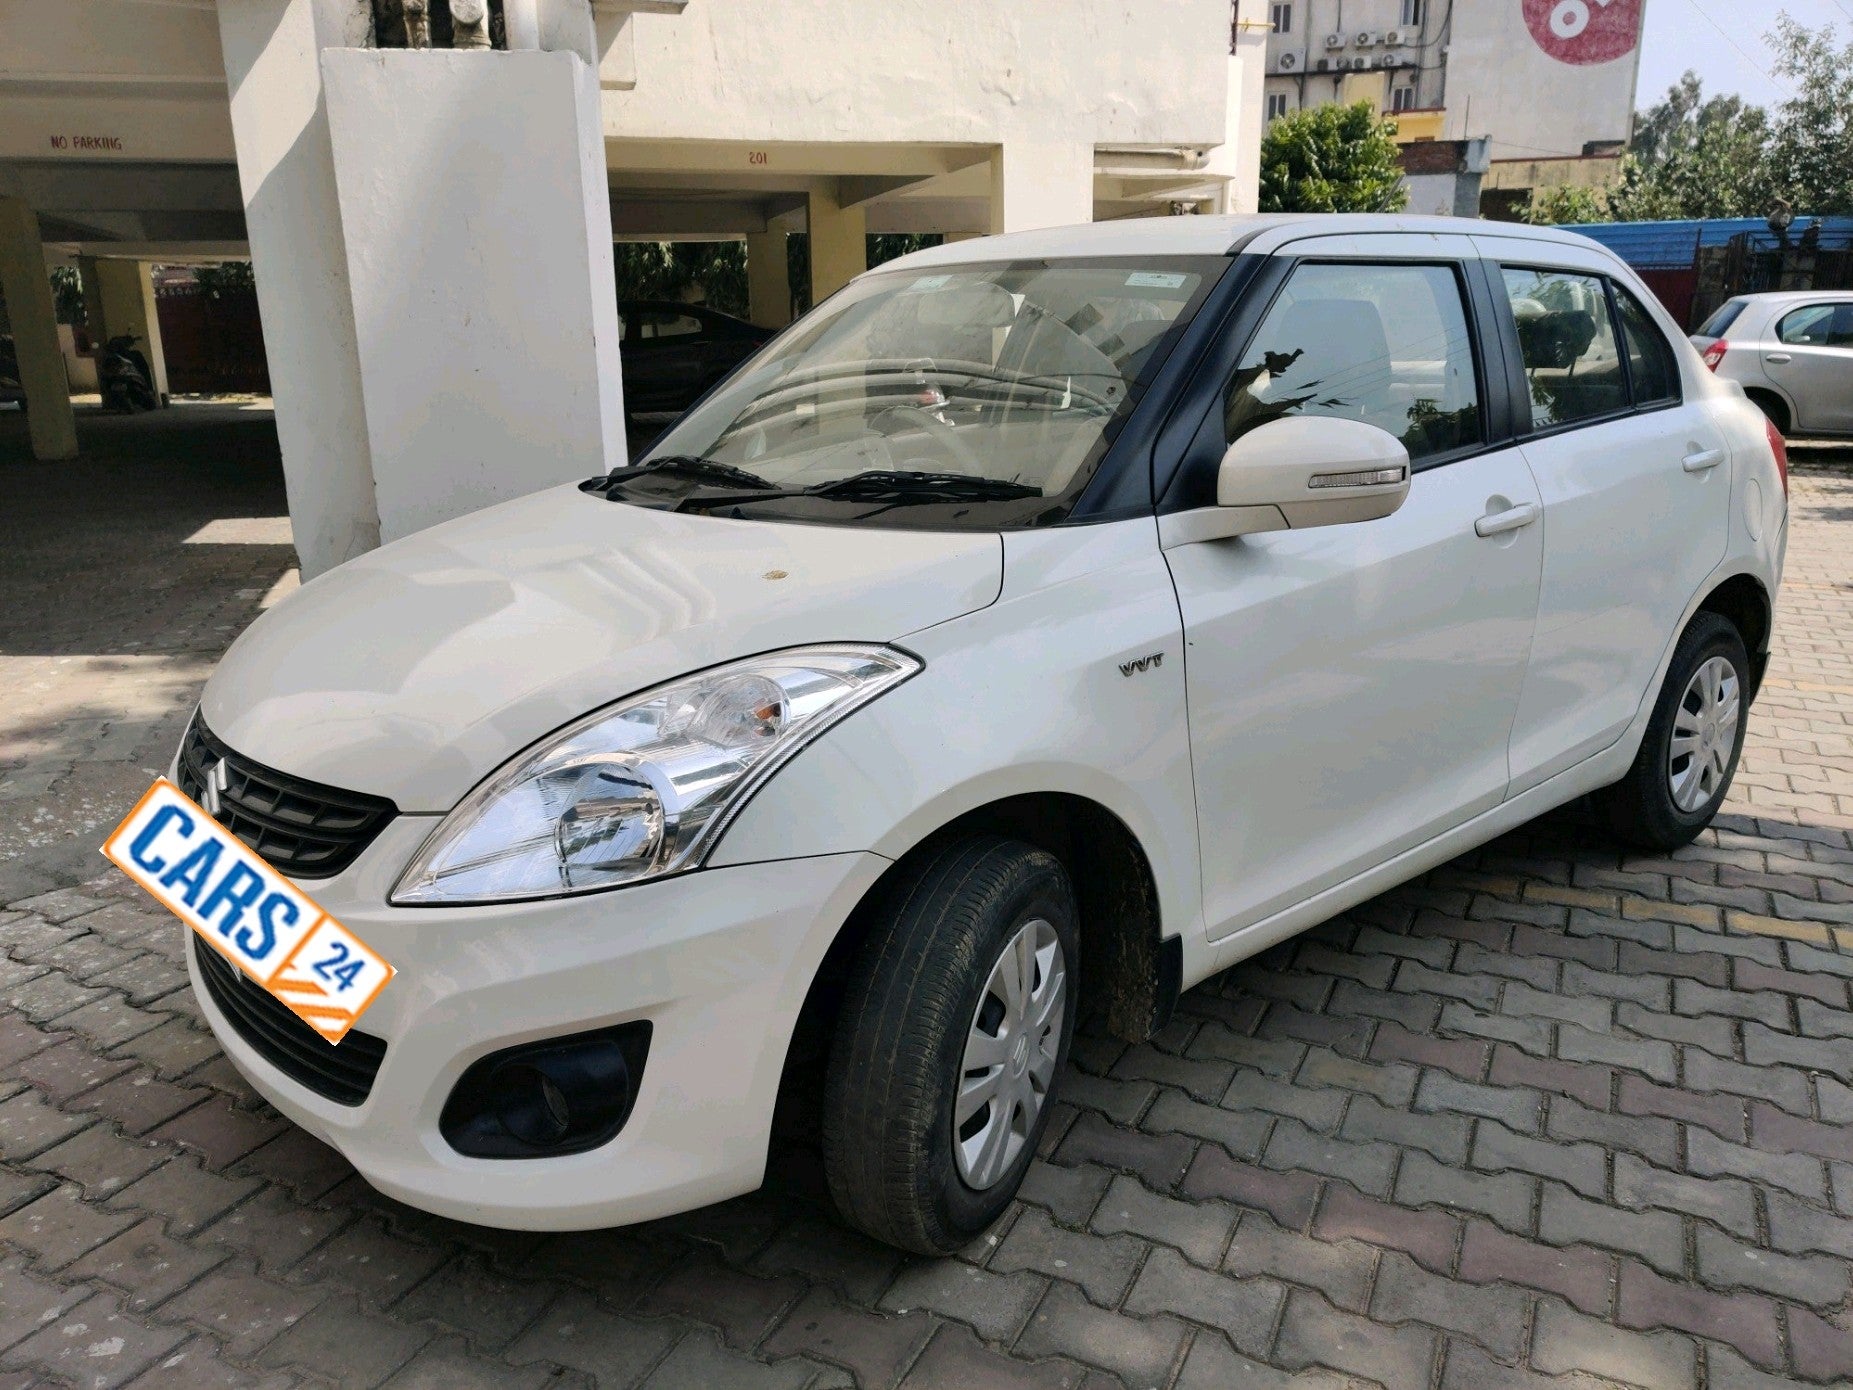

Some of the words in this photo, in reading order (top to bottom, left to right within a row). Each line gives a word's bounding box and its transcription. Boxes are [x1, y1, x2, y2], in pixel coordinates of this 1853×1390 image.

[50, 136, 67, 149] NO
[73, 136, 122, 150] PARKING
[749, 152, 767, 164] 201
[1119, 652, 1164, 677] VVT
